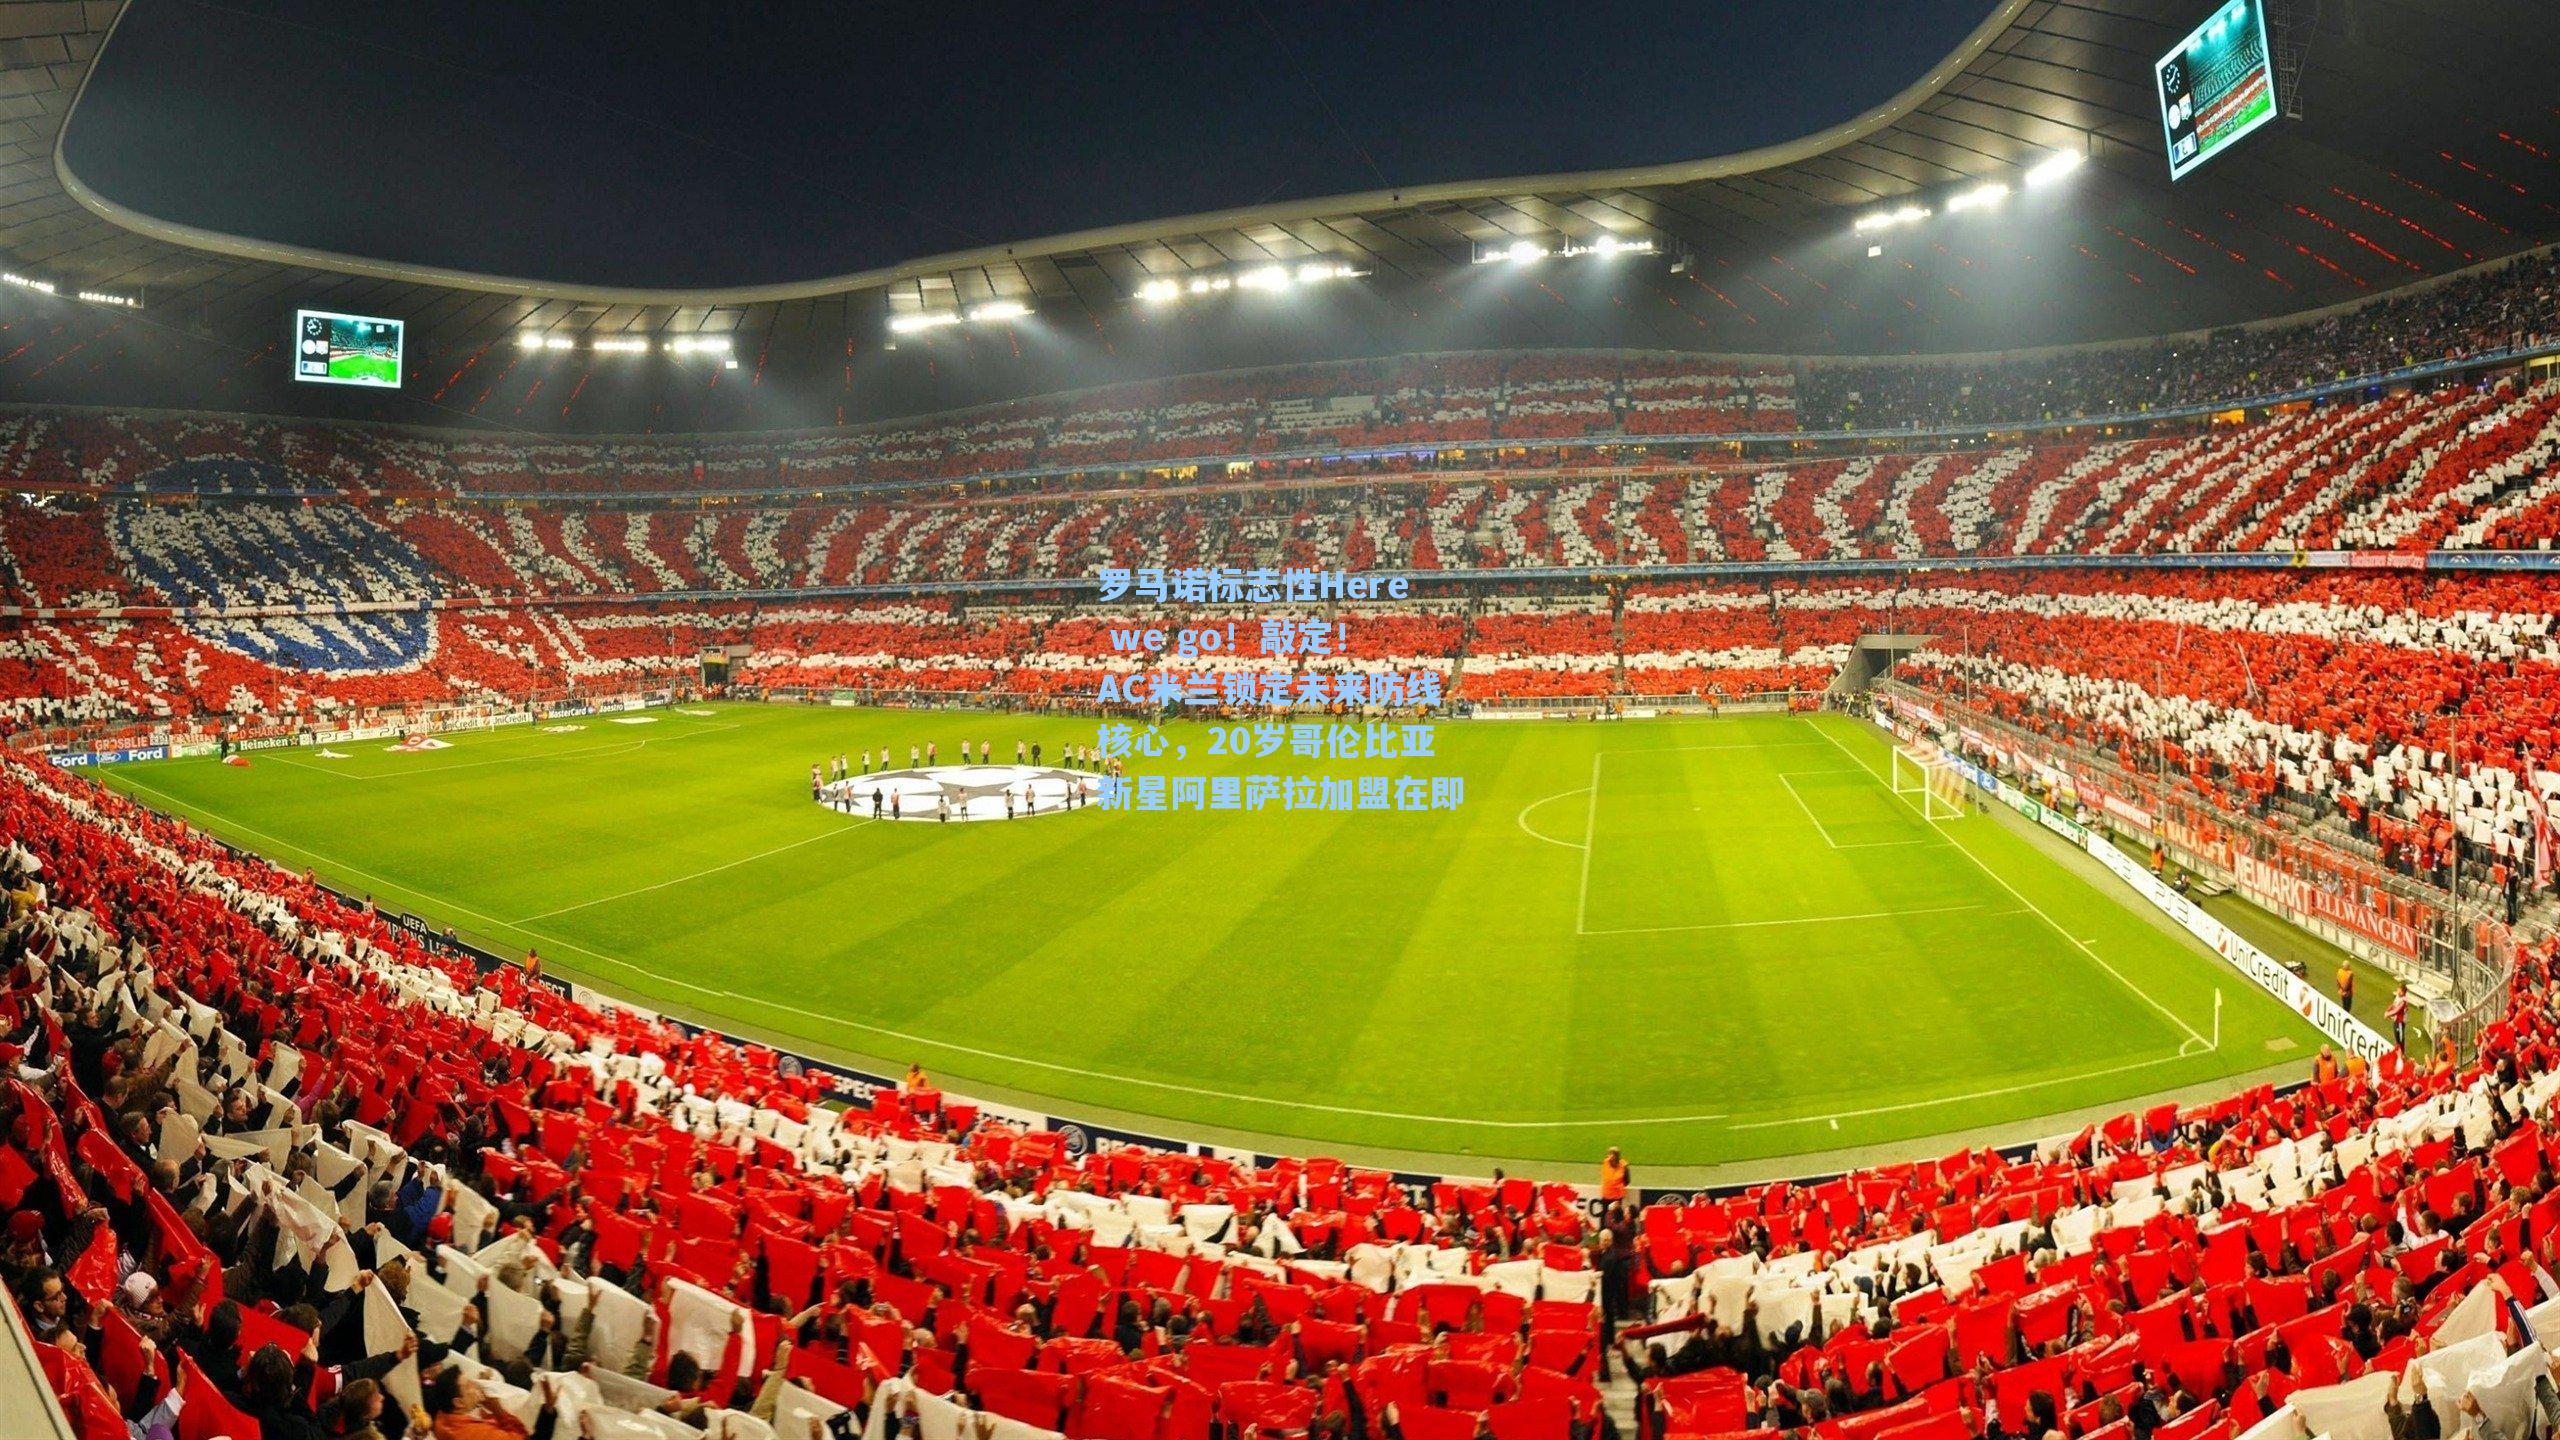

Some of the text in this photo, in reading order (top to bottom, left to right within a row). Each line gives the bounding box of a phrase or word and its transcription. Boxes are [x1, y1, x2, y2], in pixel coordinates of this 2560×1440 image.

[128, 748, 162, 761] Ford
[240, 737, 288, 751] Heineken
[52, 754, 88, 767] Ford
[2234, 851, 2312, 916] NEUMARKT
[402, 914, 428, 935] UEFA
[2316, 889, 2415, 954] ELLWANGEN
[2230, 936, 2289, 1000] UniCredit
